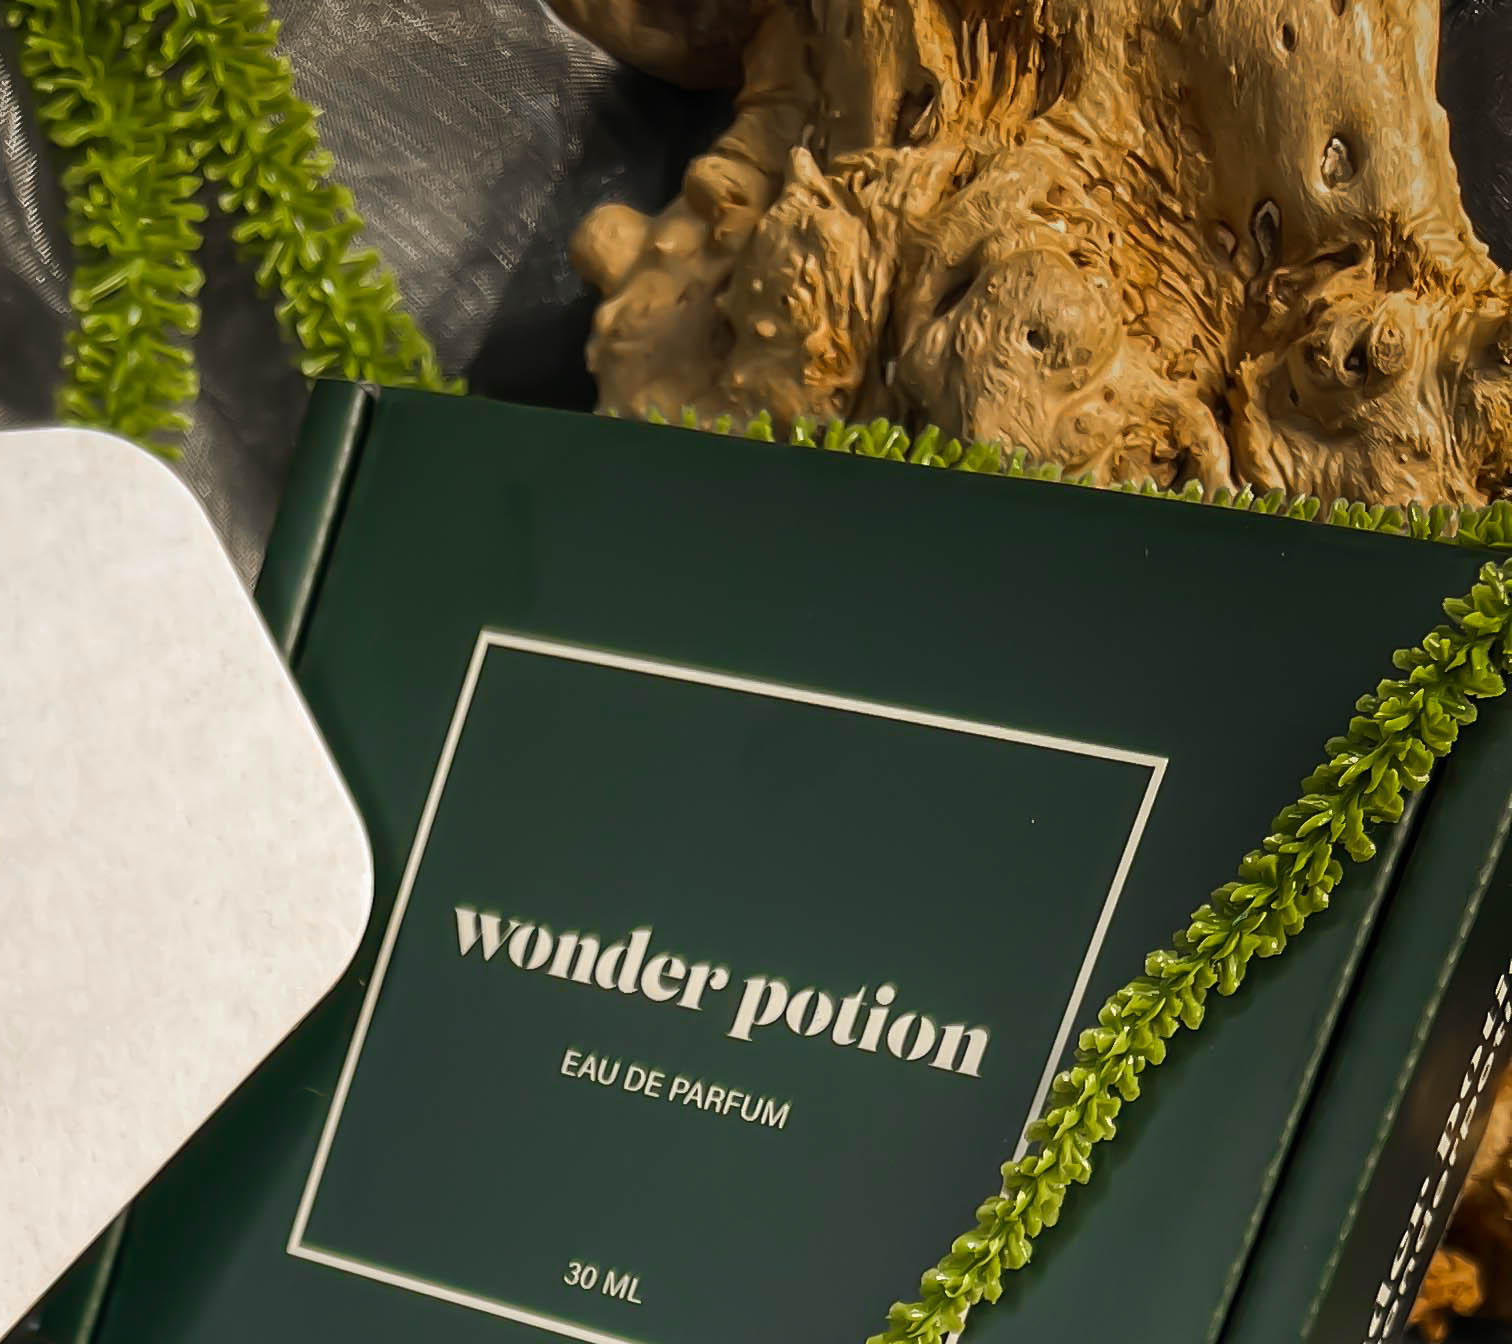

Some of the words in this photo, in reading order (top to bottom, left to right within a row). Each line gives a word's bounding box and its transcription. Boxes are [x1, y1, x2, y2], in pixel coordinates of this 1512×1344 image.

[454, 905, 730, 1011] wonder
[725, 975, 990, 1078] potion
[560, 1047, 621, 1086] EAU
[623, 1064, 666, 1098] DE
[668, 1075, 791, 1131] PARFUM
[1435, 958, 1512, 1162] poti
[563, 1260, 598, 1291] 30
[601, 1272, 643, 1305] ML
